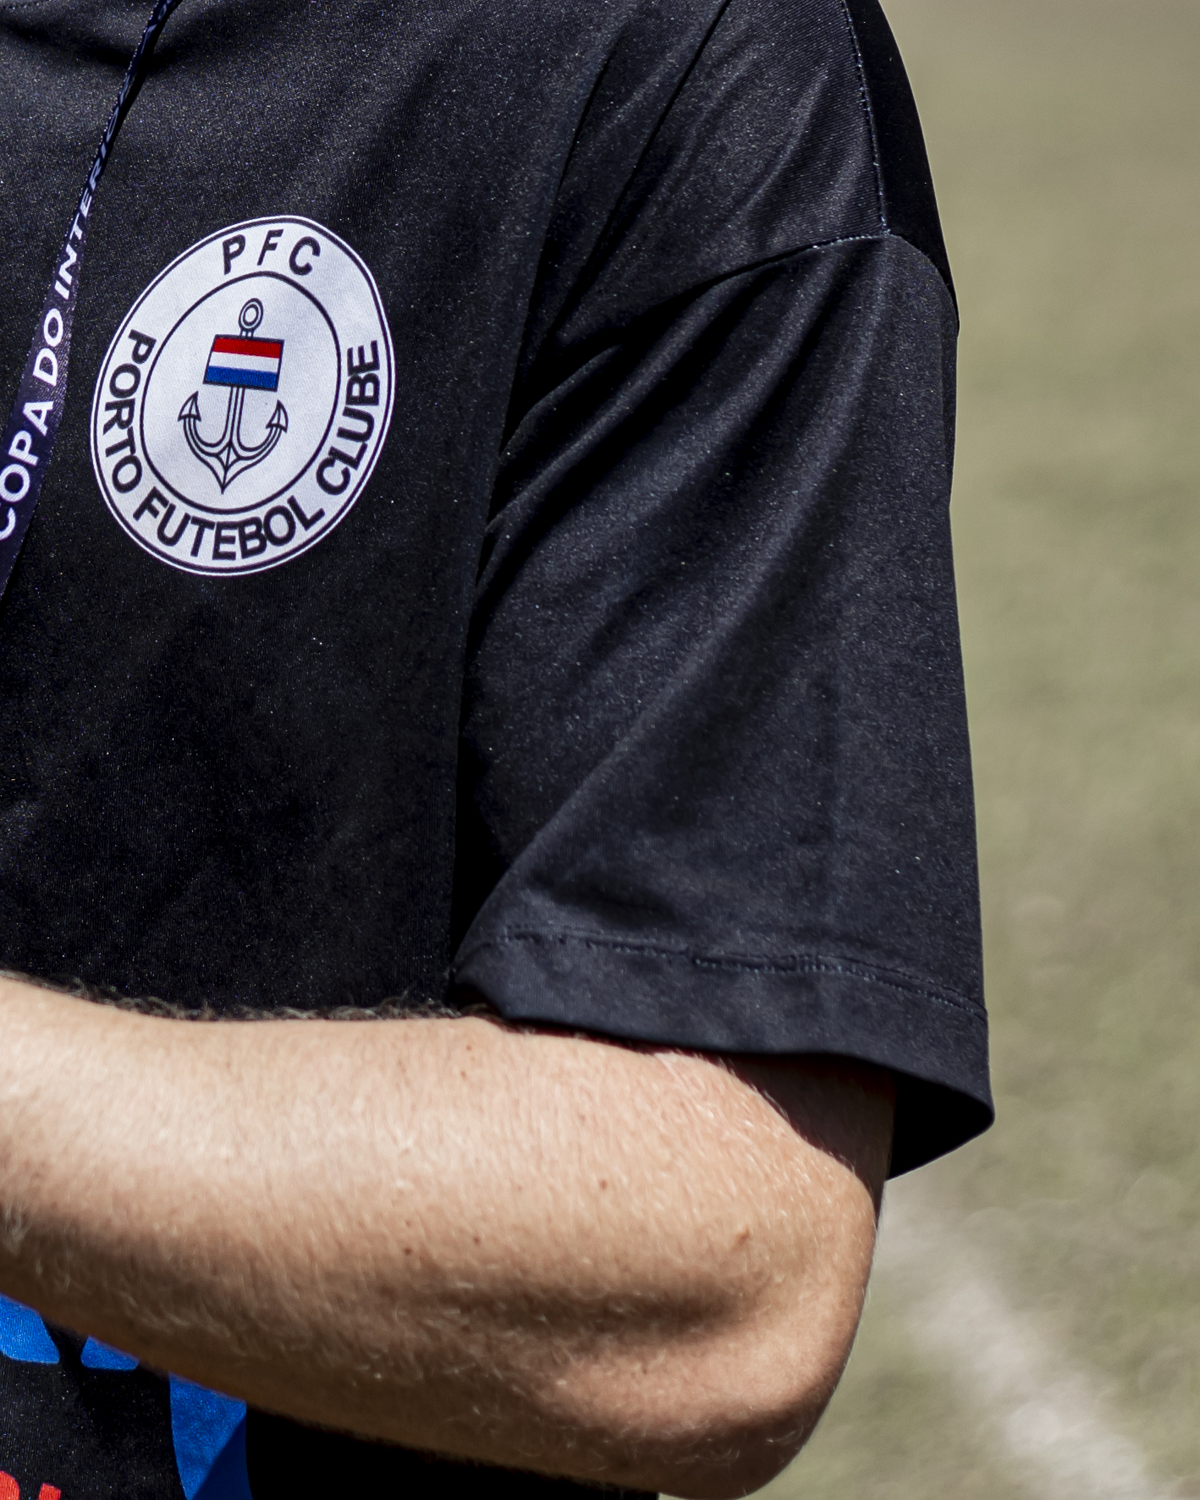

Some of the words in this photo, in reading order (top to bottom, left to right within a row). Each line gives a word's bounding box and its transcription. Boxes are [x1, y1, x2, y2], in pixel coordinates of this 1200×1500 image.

[222, 229, 321, 276] PFC
[33, 308, 65, 388] DO
[103, 329, 157, 494] PORTO
[132, 486, 325, 561] FUTEBOL
[316, 340, 381, 496] CLUBE
